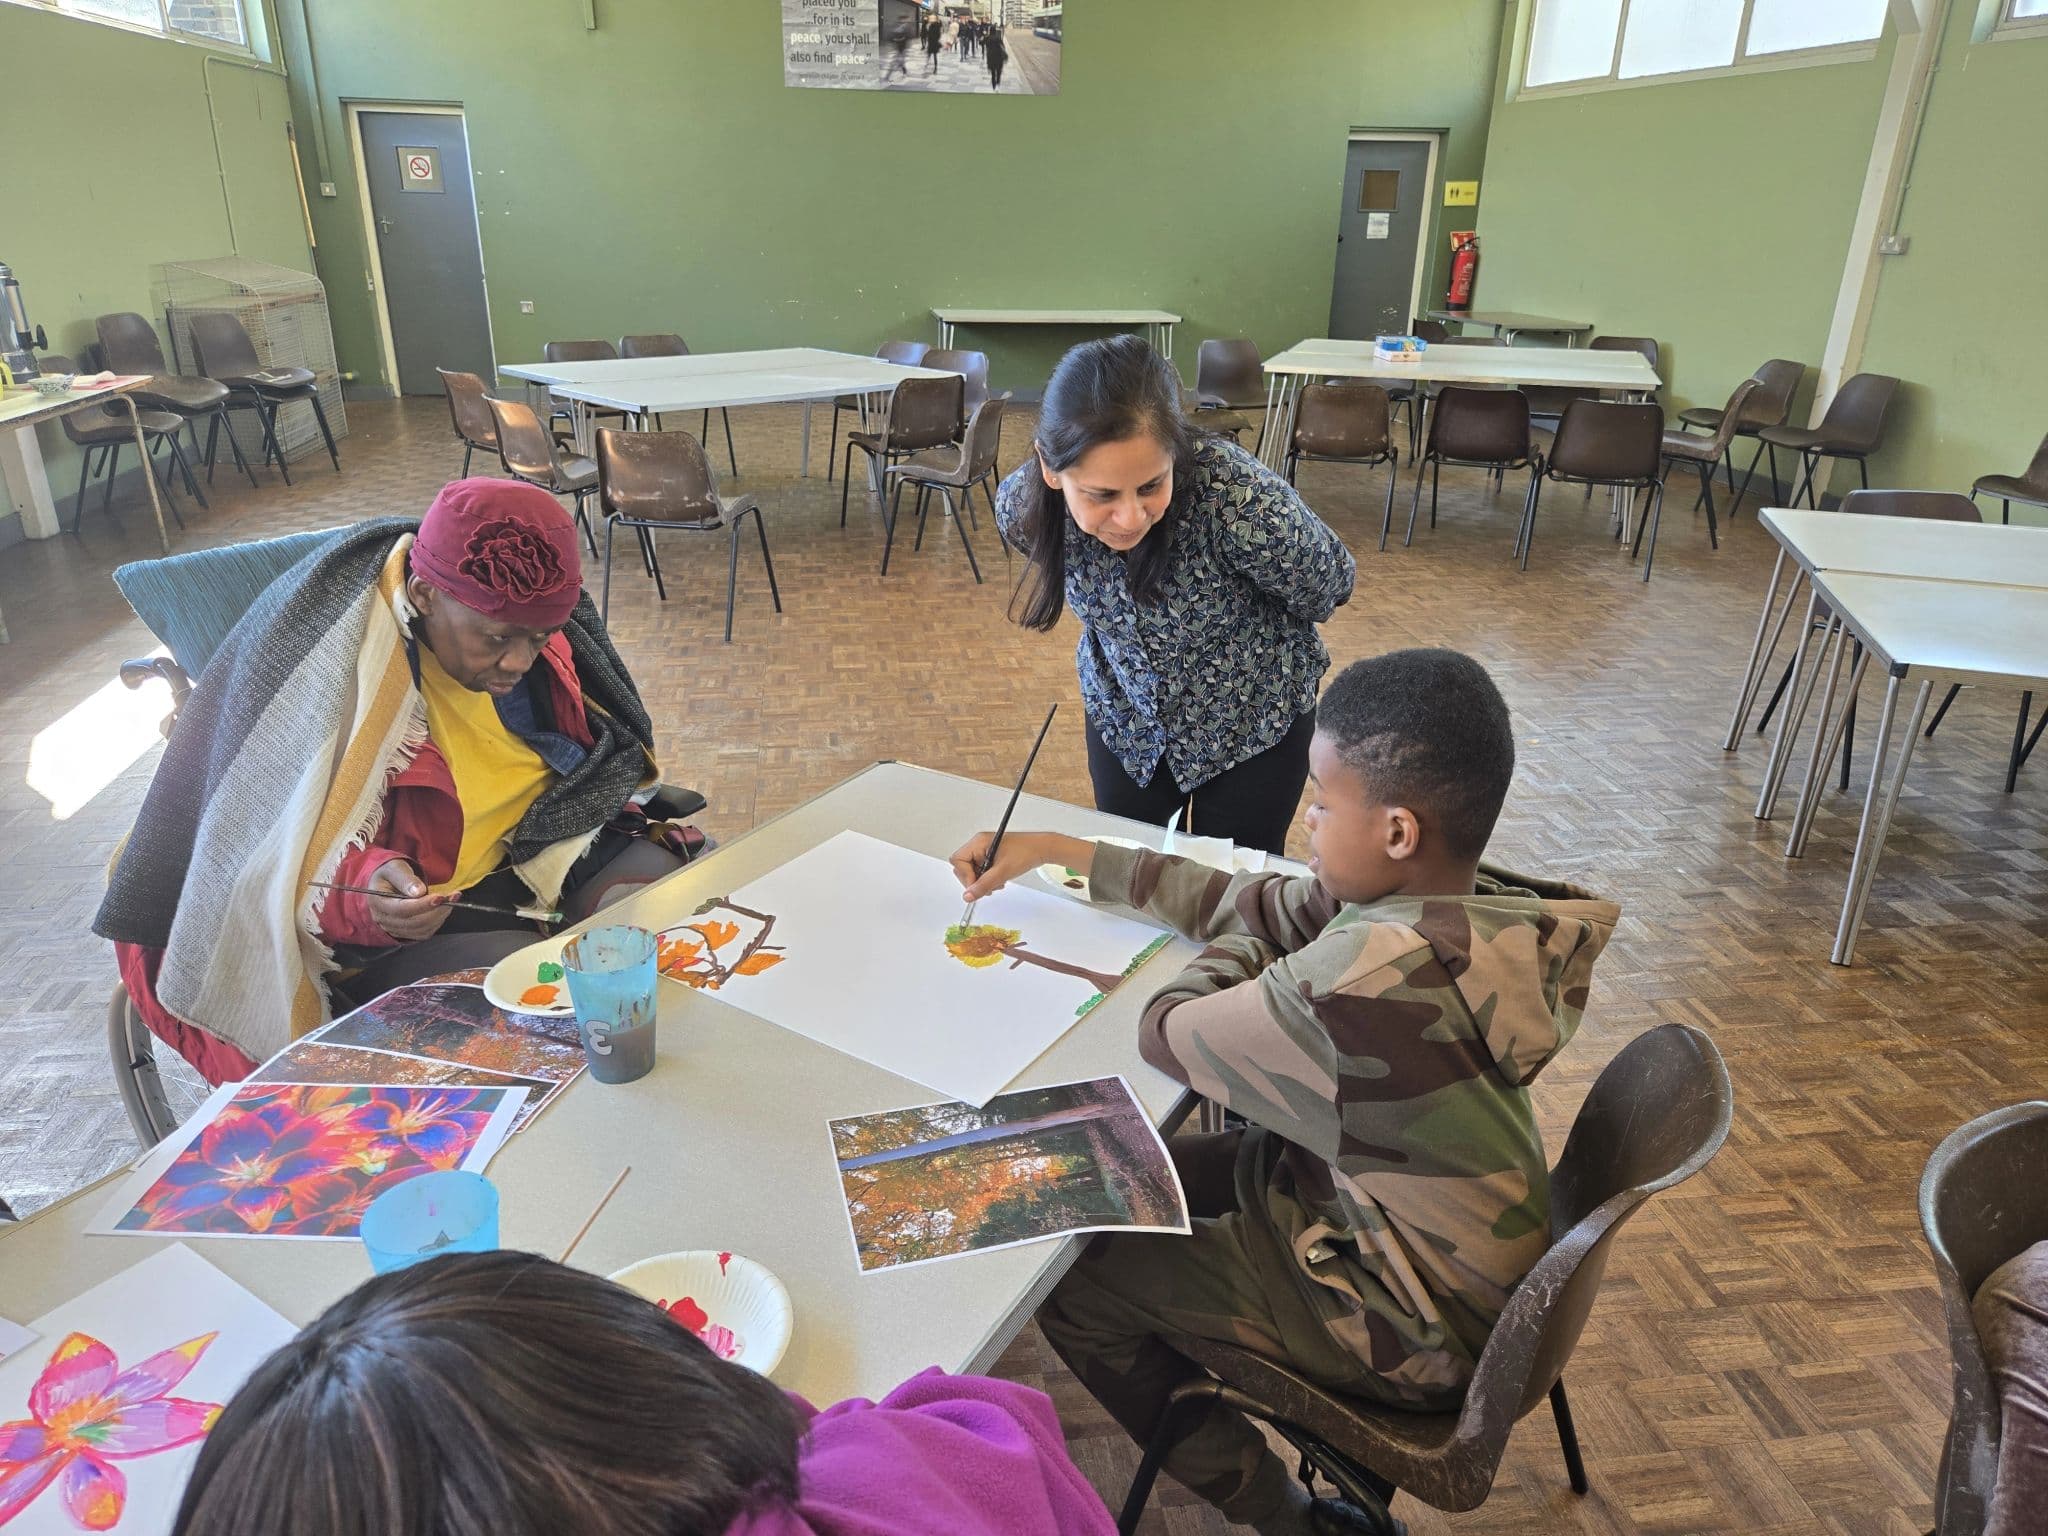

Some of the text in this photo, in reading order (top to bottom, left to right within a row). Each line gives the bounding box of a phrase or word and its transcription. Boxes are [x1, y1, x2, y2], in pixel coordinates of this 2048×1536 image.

[839, 0, 856, 9] you
[830, 13, 839, 26] in
[842, 13, 855, 26] its
[790, 32, 870, 46] peace, you shall
[790, 51, 811, 63] also
[814, 51, 833, 63] find
